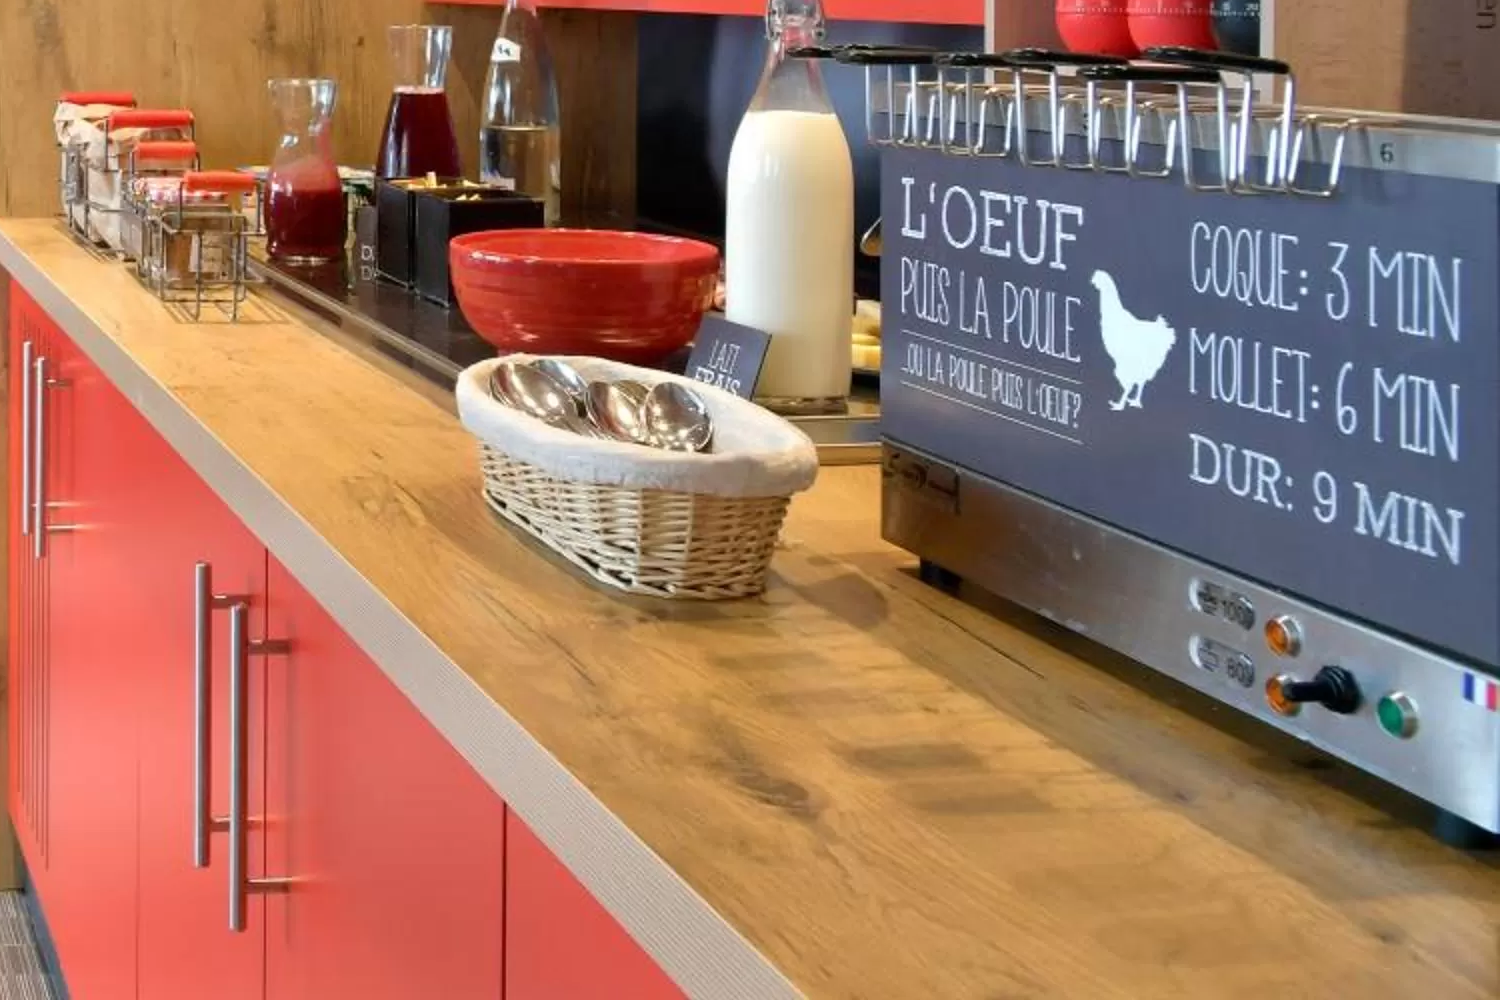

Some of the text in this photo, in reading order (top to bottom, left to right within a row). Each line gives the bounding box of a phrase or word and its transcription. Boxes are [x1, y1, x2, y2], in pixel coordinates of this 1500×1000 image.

[1380, 143, 1394, 164] 6
[901, 177, 1083, 270] L'OEUF
[901, 256, 1082, 362] PUIS LA POULE
[1191, 222, 1461, 343] COQUE: 3 MIN
[708, 338, 741, 375] LAIT
[927, 348, 945, 385] LA
[949, 354, 988, 399] POULE
[991, 367, 1023, 410] PUIS
[1027, 378, 1082, 429] L'OEUF?
[1189, 327, 1460, 462] MOLLET: 6 MIN
[1189, 433, 1465, 565] DUR: 9 MIN
